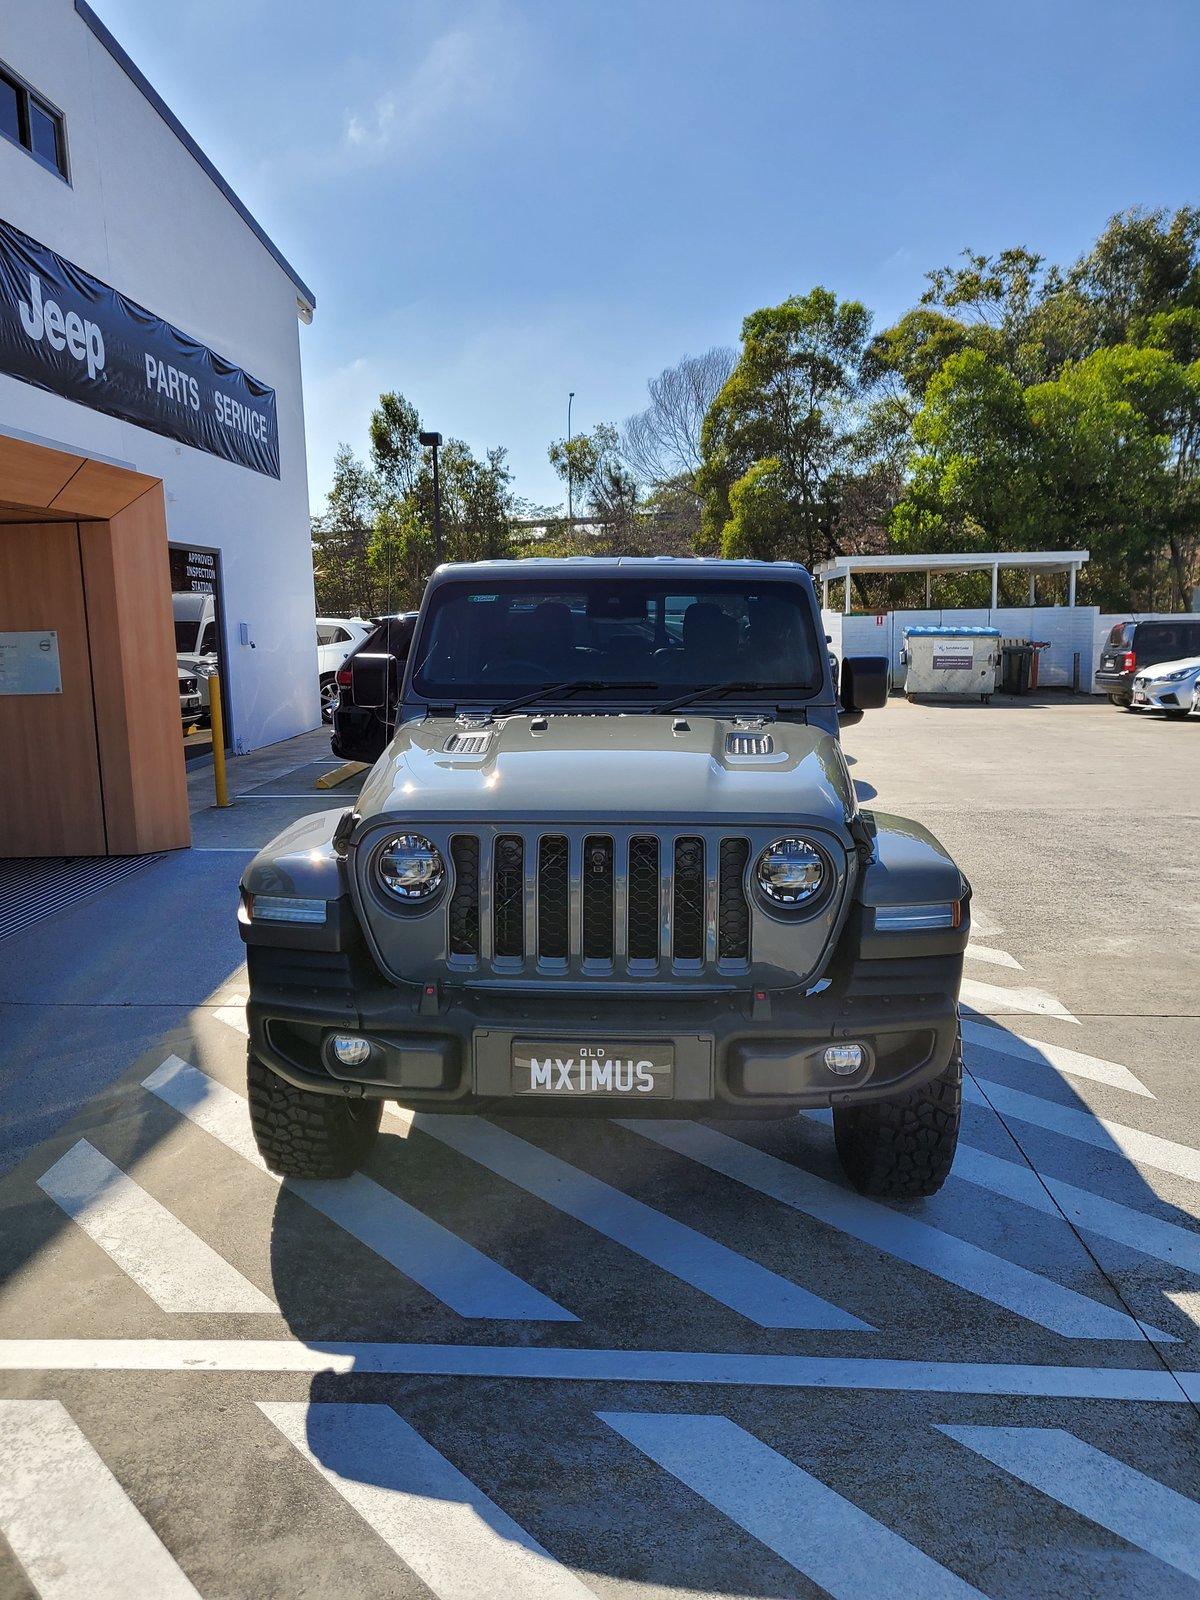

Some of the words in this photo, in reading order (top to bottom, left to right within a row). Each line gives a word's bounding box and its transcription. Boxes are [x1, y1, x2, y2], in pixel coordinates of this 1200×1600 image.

[19, 272, 105, 380] Jeep
[144, 353, 200, 411] PARTS
[214, 390, 268, 443] SERVICE
[188, 551, 214, 566] APPROVED
[186, 565, 216, 579] INSPECTION
[191, 580, 213, 593] STATION
[579, 1048, 605, 1057] QLD
[530, 1058, 654, 1092] MXIMUS
